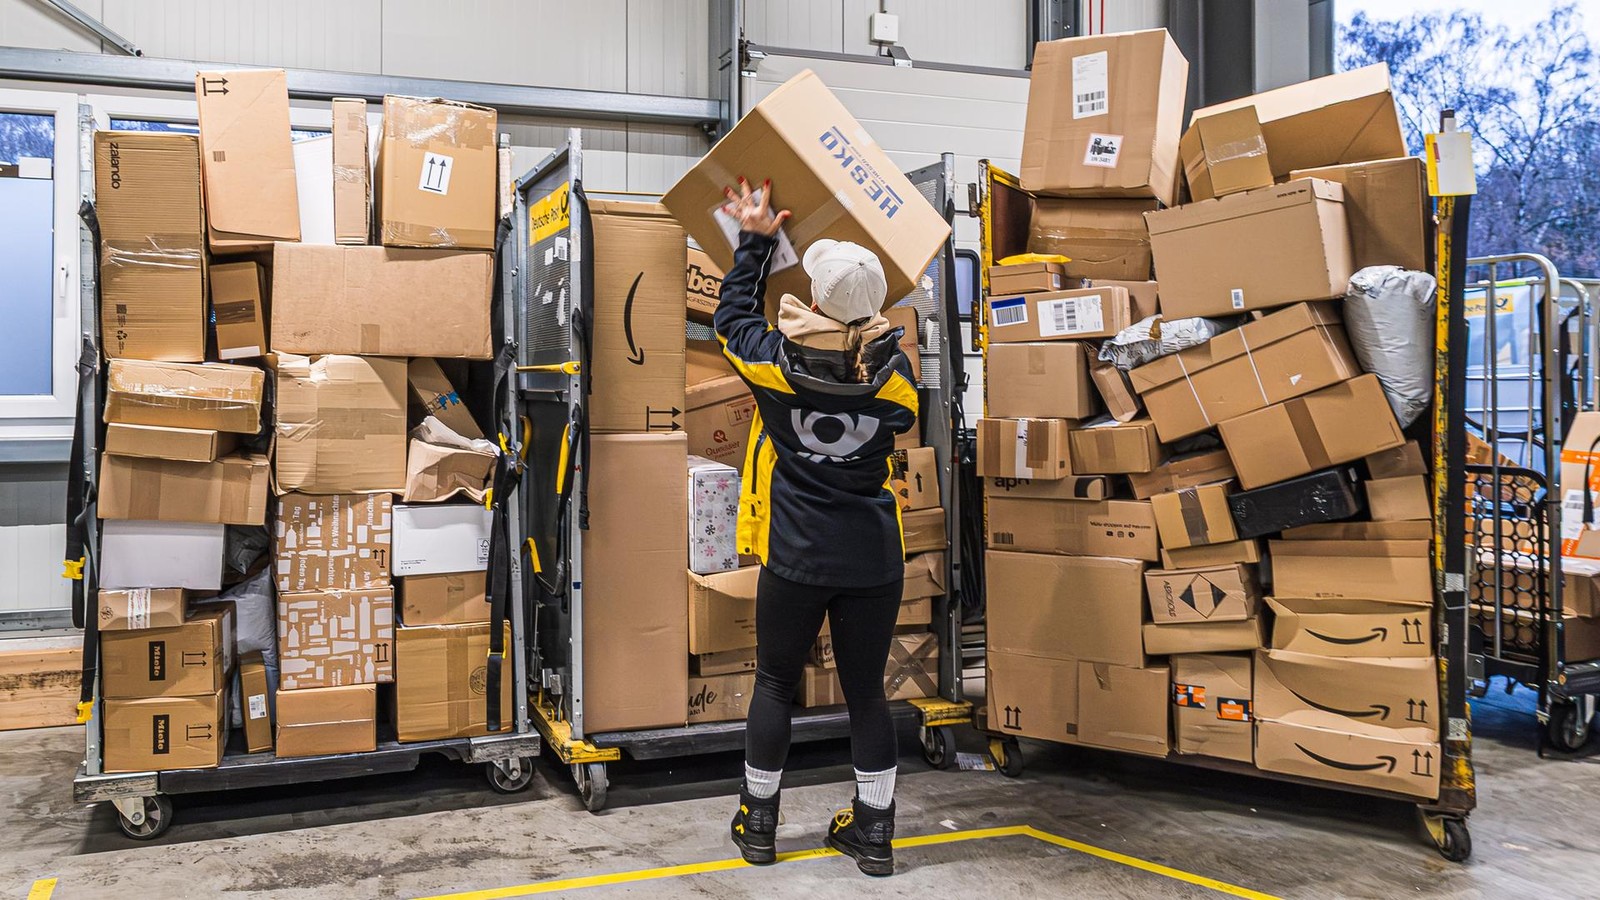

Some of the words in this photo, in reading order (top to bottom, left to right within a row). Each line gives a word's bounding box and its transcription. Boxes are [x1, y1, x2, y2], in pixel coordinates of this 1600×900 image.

[110, 142, 122, 190] zalando
[819, 131, 899, 219] HESKO
[157, 719, 165, 750] Miele
